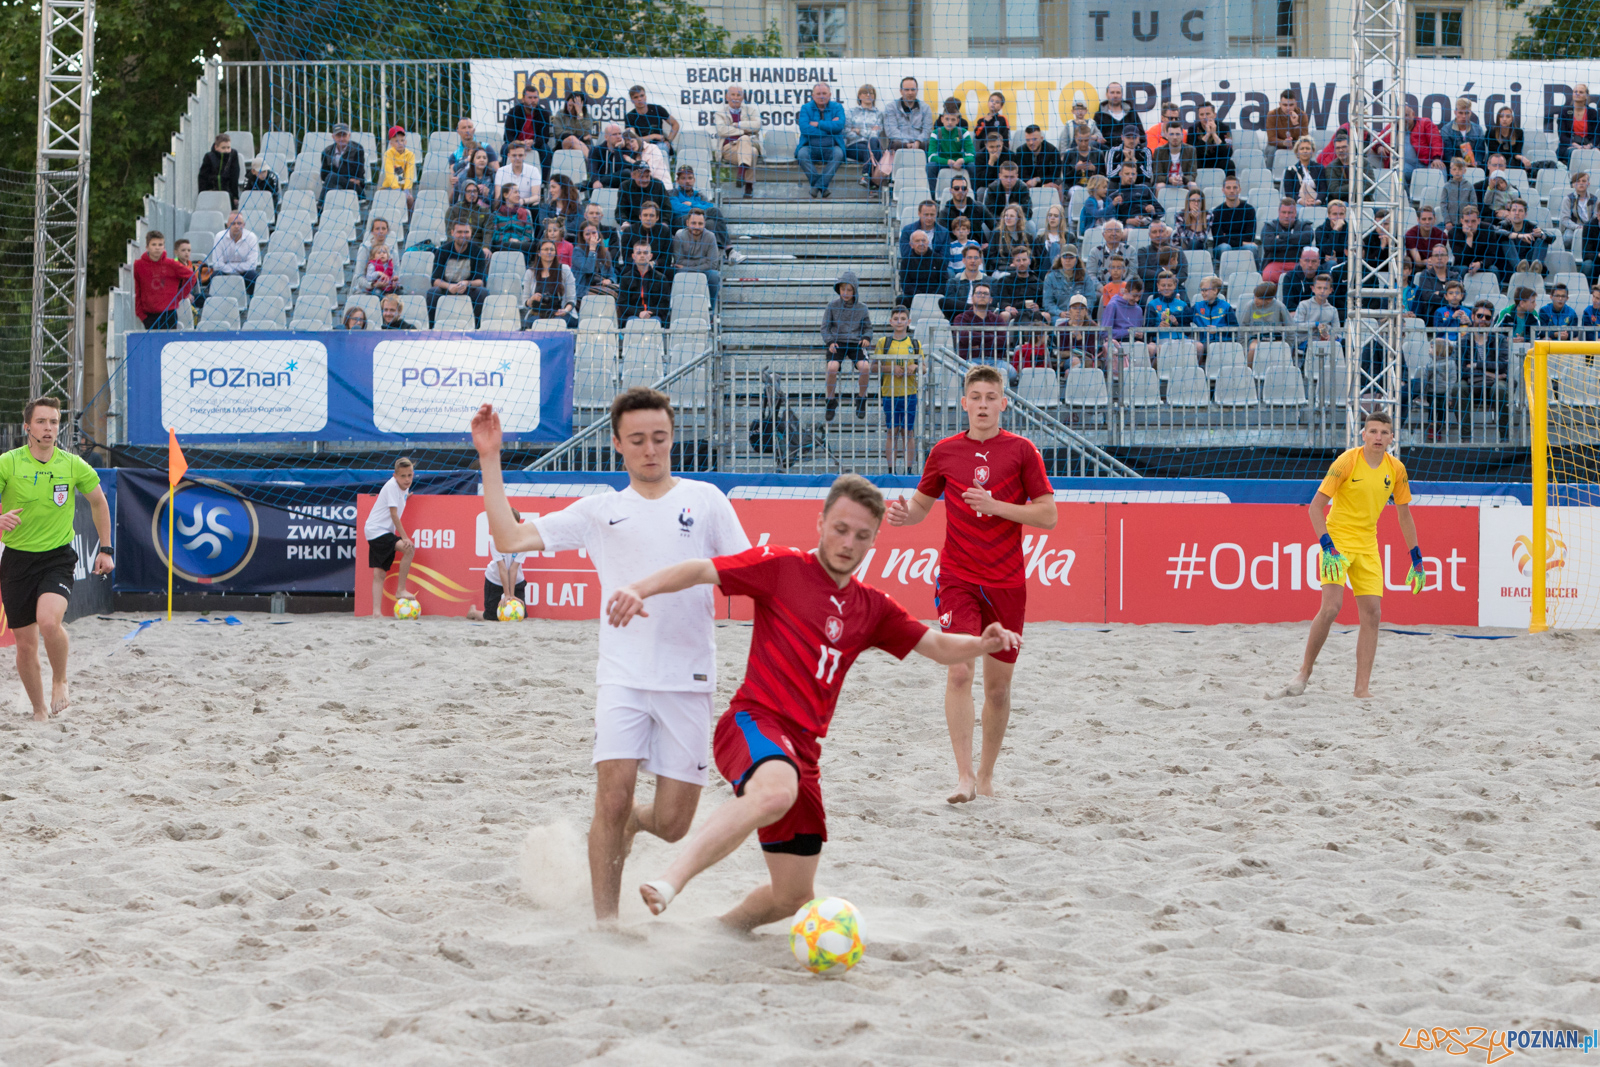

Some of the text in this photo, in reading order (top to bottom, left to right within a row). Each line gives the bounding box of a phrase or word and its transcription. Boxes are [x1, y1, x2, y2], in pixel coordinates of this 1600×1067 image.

[687, 67, 838, 83] BEACH HANDBALL
[743, 89, 844, 104] VOLLEYBL
[411, 529, 455, 549] 1919
[286, 545, 331, 560] PIŁKI
[881, 547, 940, 585] na
[1166, 541, 1467, 592] #Od10Lat
[546, 582, 588, 607] LAT
[815, 644, 843, 684] 17
